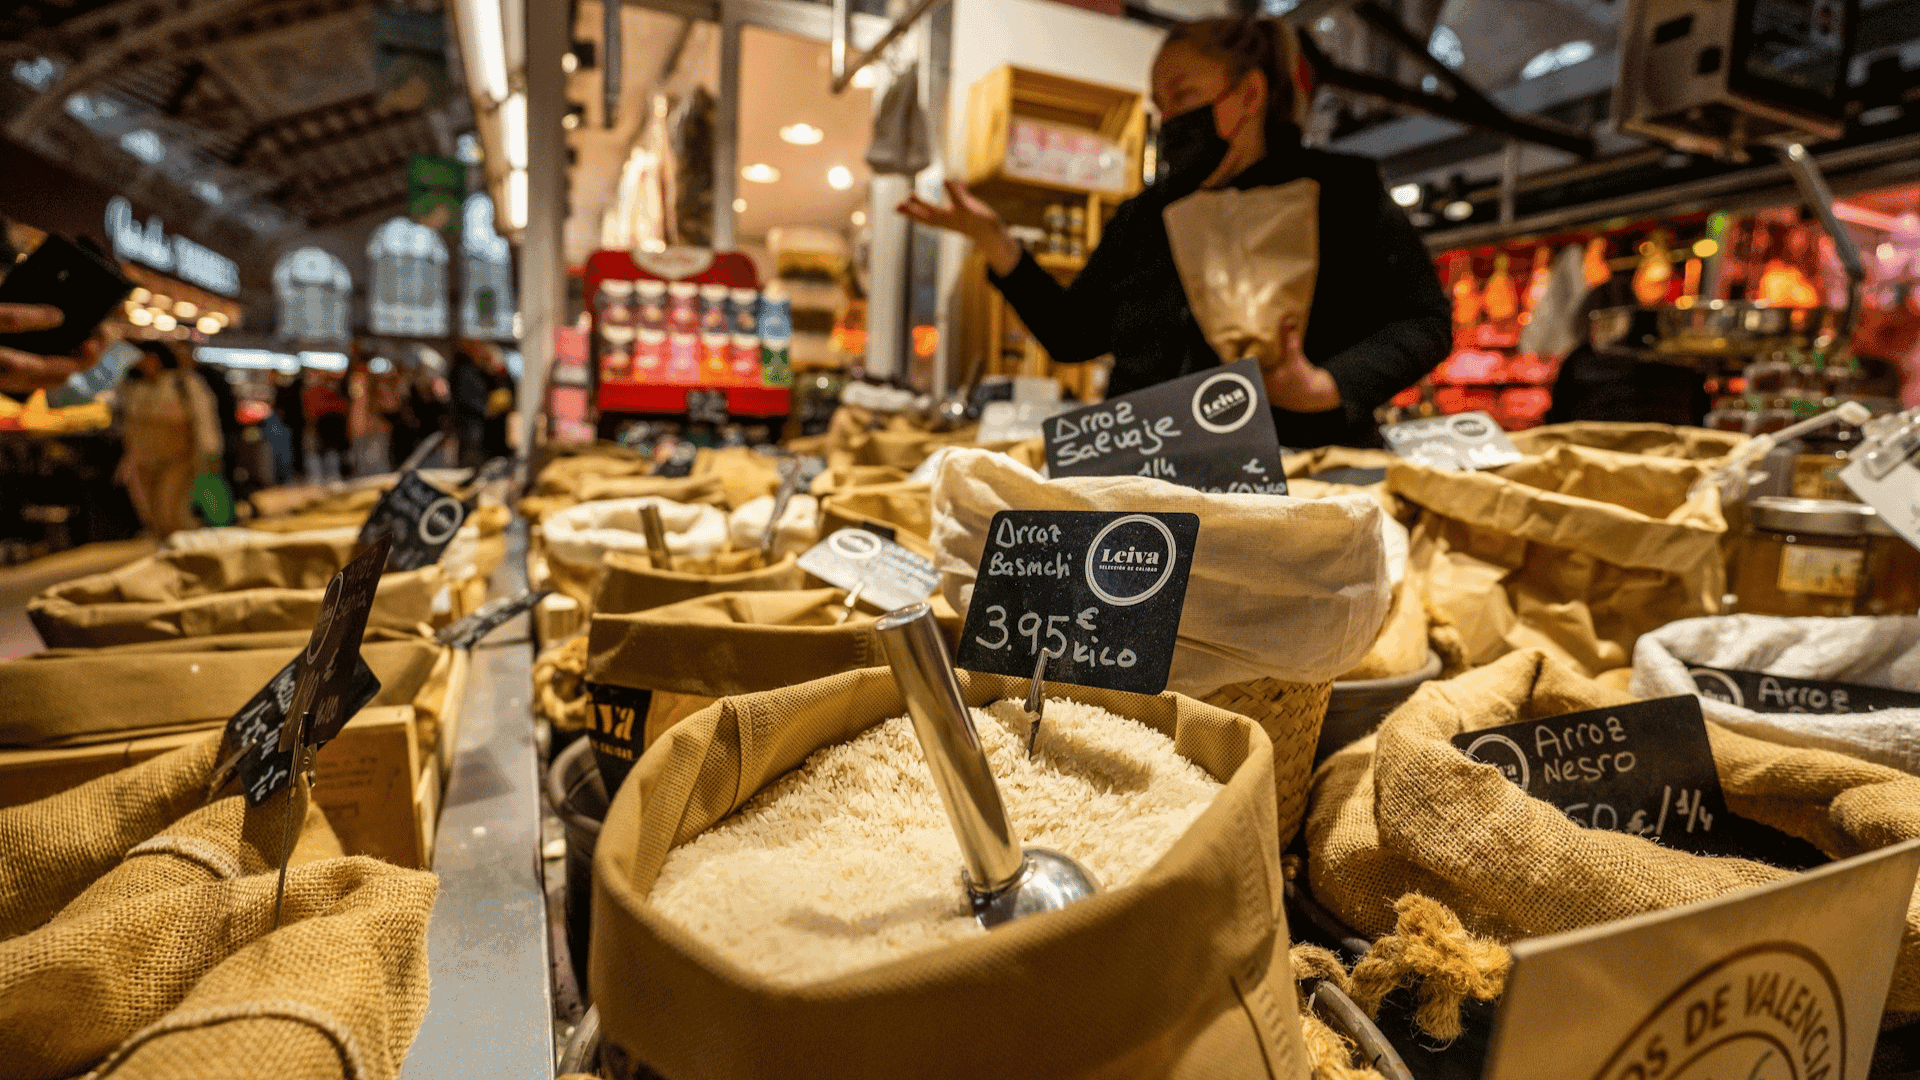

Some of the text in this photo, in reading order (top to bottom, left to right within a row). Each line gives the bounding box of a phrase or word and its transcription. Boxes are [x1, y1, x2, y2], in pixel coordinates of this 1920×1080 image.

[1052, 402, 1135, 443] Arroz
[1101, 545, 1160, 565] Leiva
[975, 604, 1100, 660] 3.95 €
[1534, 716, 1628, 758] Arroz
[1684, 983, 1732, 1046] DE
